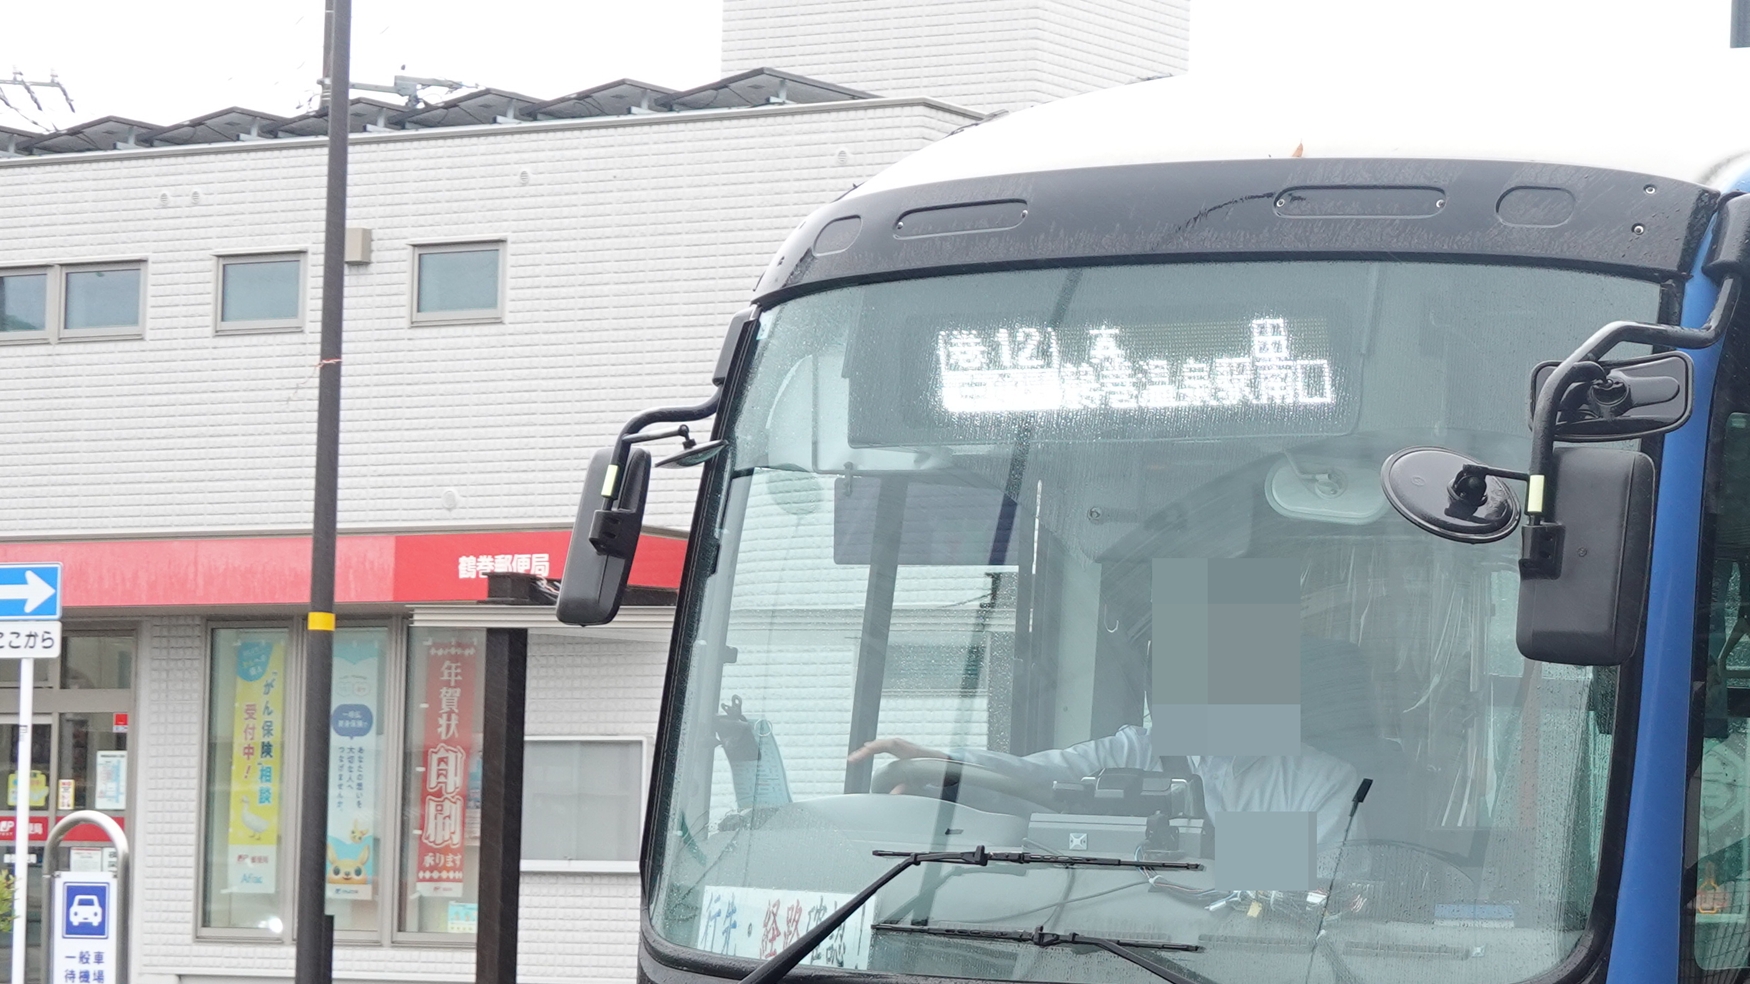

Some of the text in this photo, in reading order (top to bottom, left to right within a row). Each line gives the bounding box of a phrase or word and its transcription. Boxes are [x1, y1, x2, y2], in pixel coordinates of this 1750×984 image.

[458, 553, 549, 578] 鶴巻郵便局
[437, 660, 462, 741] 年賀状
[426, 743, 466, 849] 印刷
[422, 852, 462, 868] 承ります
[64, 950, 105, 965] 一般車
[64, 969, 105, 984] 待機場
